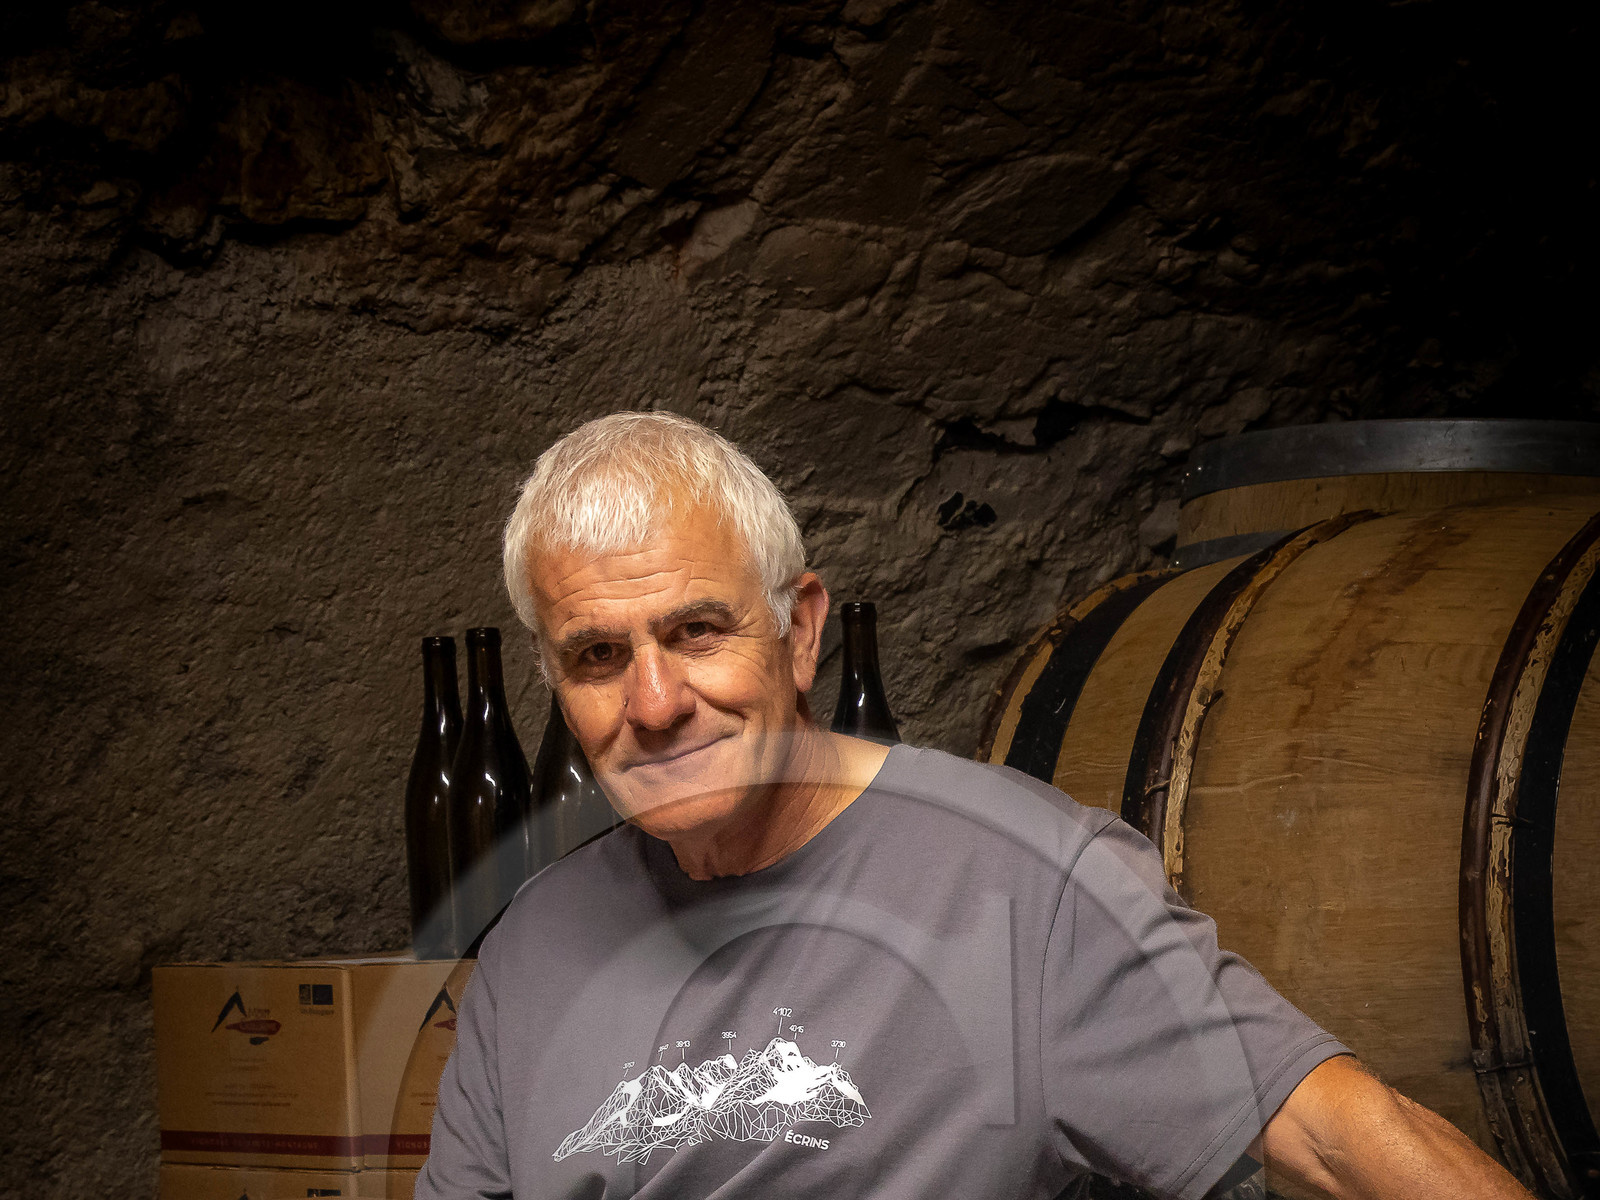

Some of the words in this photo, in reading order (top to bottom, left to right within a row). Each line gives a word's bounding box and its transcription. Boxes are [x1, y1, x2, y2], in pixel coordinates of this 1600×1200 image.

[772, 1007, 793, 1018] 4102
[789, 1024, 804, 1034] 4015
[721, 1031, 737, 1039] 3954
[675, 1040, 691, 1048] 3913
[784, 1129, 830, 1151] ÉCRINS
